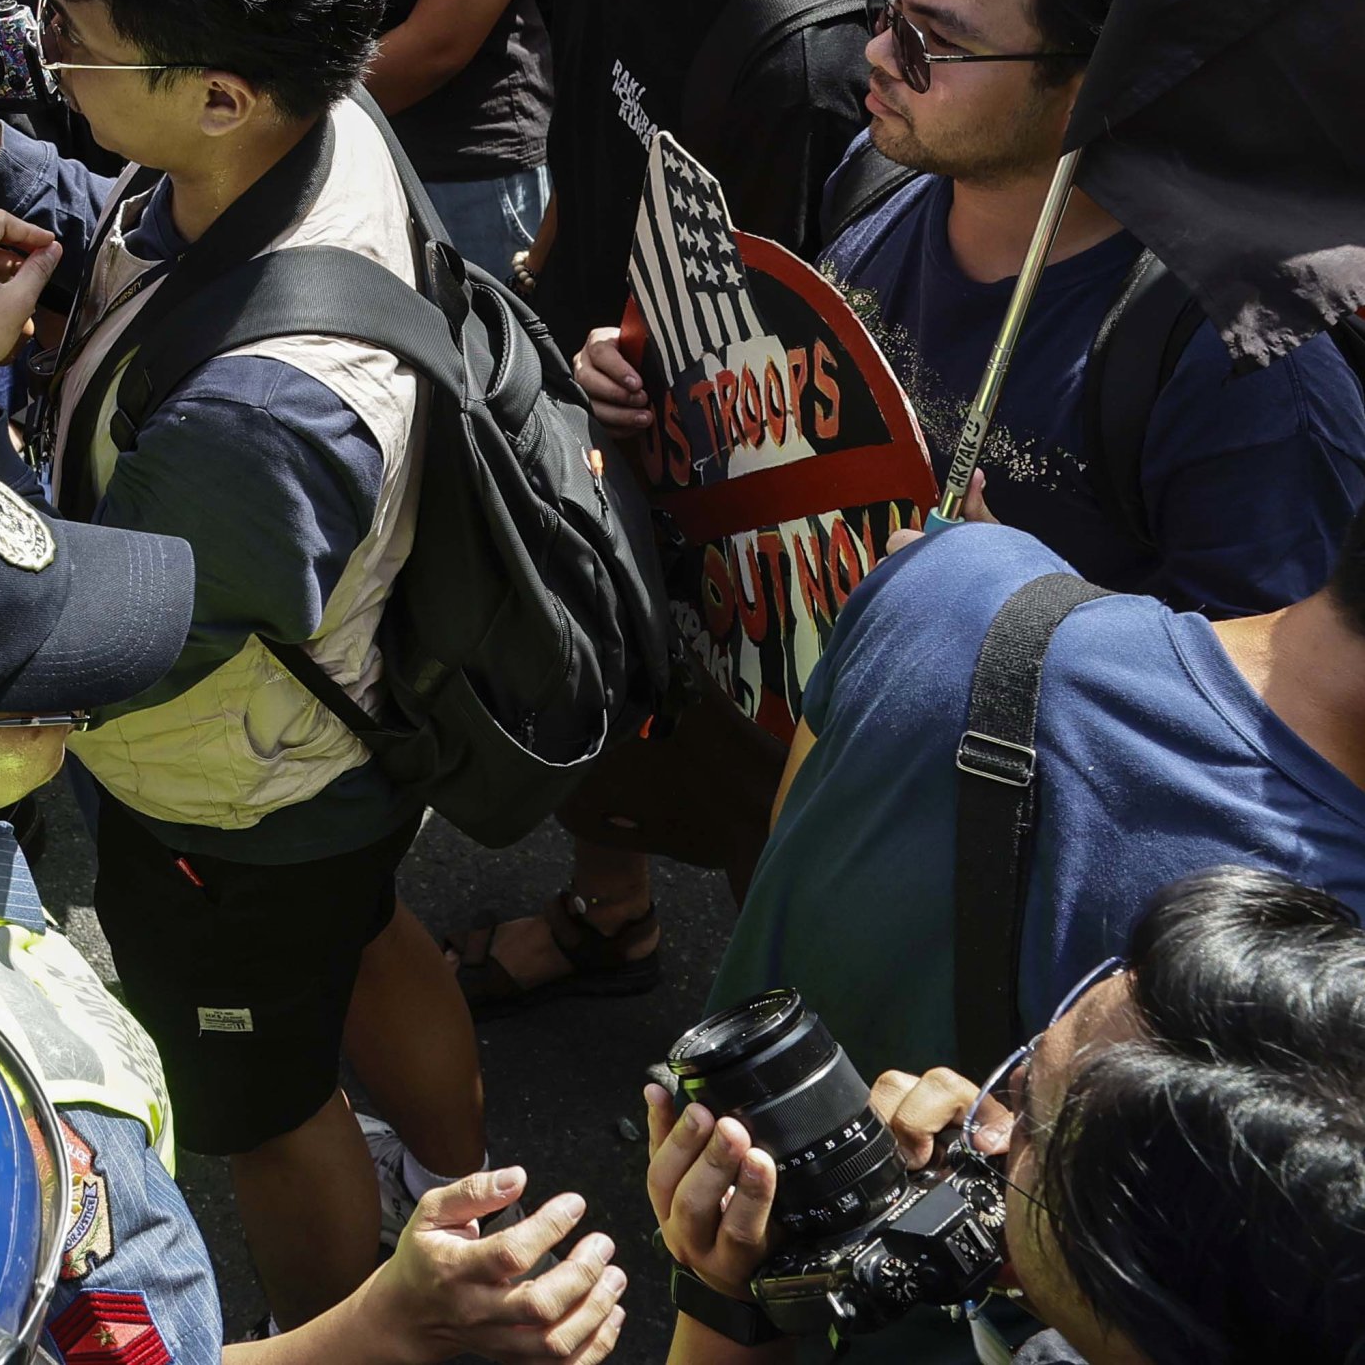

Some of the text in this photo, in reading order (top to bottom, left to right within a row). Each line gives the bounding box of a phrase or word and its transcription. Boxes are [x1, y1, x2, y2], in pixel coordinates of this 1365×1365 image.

[611, 58, 646, 101] RAK!
[688, 336, 842, 462] TROOPS
[699, 530, 793, 642] OUT
[805, 1150, 816, 1161] 55
[825, 1139, 837, 1151] 35
